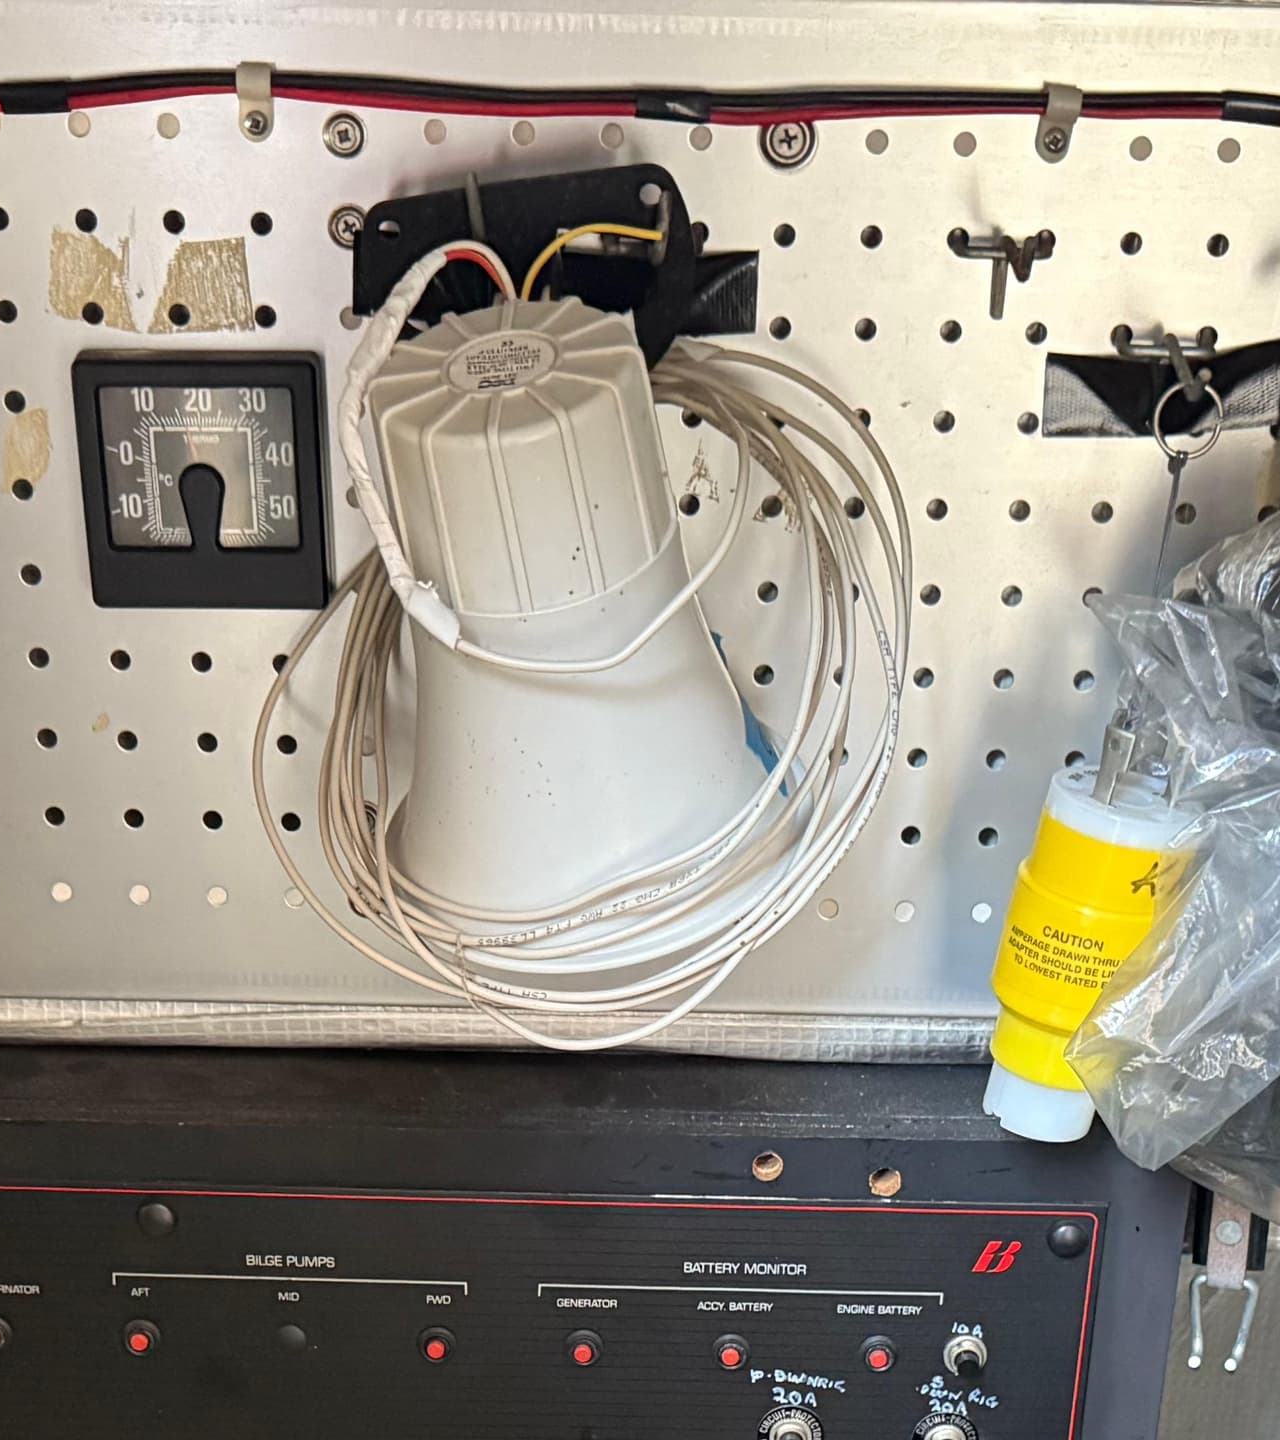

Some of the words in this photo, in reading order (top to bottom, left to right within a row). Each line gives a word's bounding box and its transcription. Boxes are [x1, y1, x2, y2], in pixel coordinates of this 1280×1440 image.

[131, 386, 154, 412] 10
[183, 387, 212, 412] 20
[239, 387, 266, 413] 30
[265, 442, 294, 467] 40
[269, 495, 295, 520] 50
[1011, 925, 1051, 953] AMPERAGE
[1052, 946, 1091, 964] DRAWN
[1042, 925, 1105, 952] CAUTION
[1008, 936, 1040, 961] ADAPTER
[1041, 955, 1082, 974] SHOULD
[1084, 968, 1100, 978] BE
[1014, 953, 1024, 965] TO
[1024, 959, 1062, 982] LOWEST
[1064, 974, 1098, 989] RATED
[245, 1255, 283, 1267] BILGE
[286, 1256, 336, 1268] PUMPS
[683, 1261, 740, 1275] BATTERY
[743, 1262, 807, 1276] MONITOR
[131, 1287, 152, 1298] AFT
[278, 1291, 300, 1302] MID
[426, 1294, 451, 1305] FWD
[557, 1298, 618, 1309] GENERATOR
[729, 1301, 773, 1312] BATTERY
[837, 1304, 876, 1315] ENGINE
[878, 1305, 923, 1316] BATTERY
